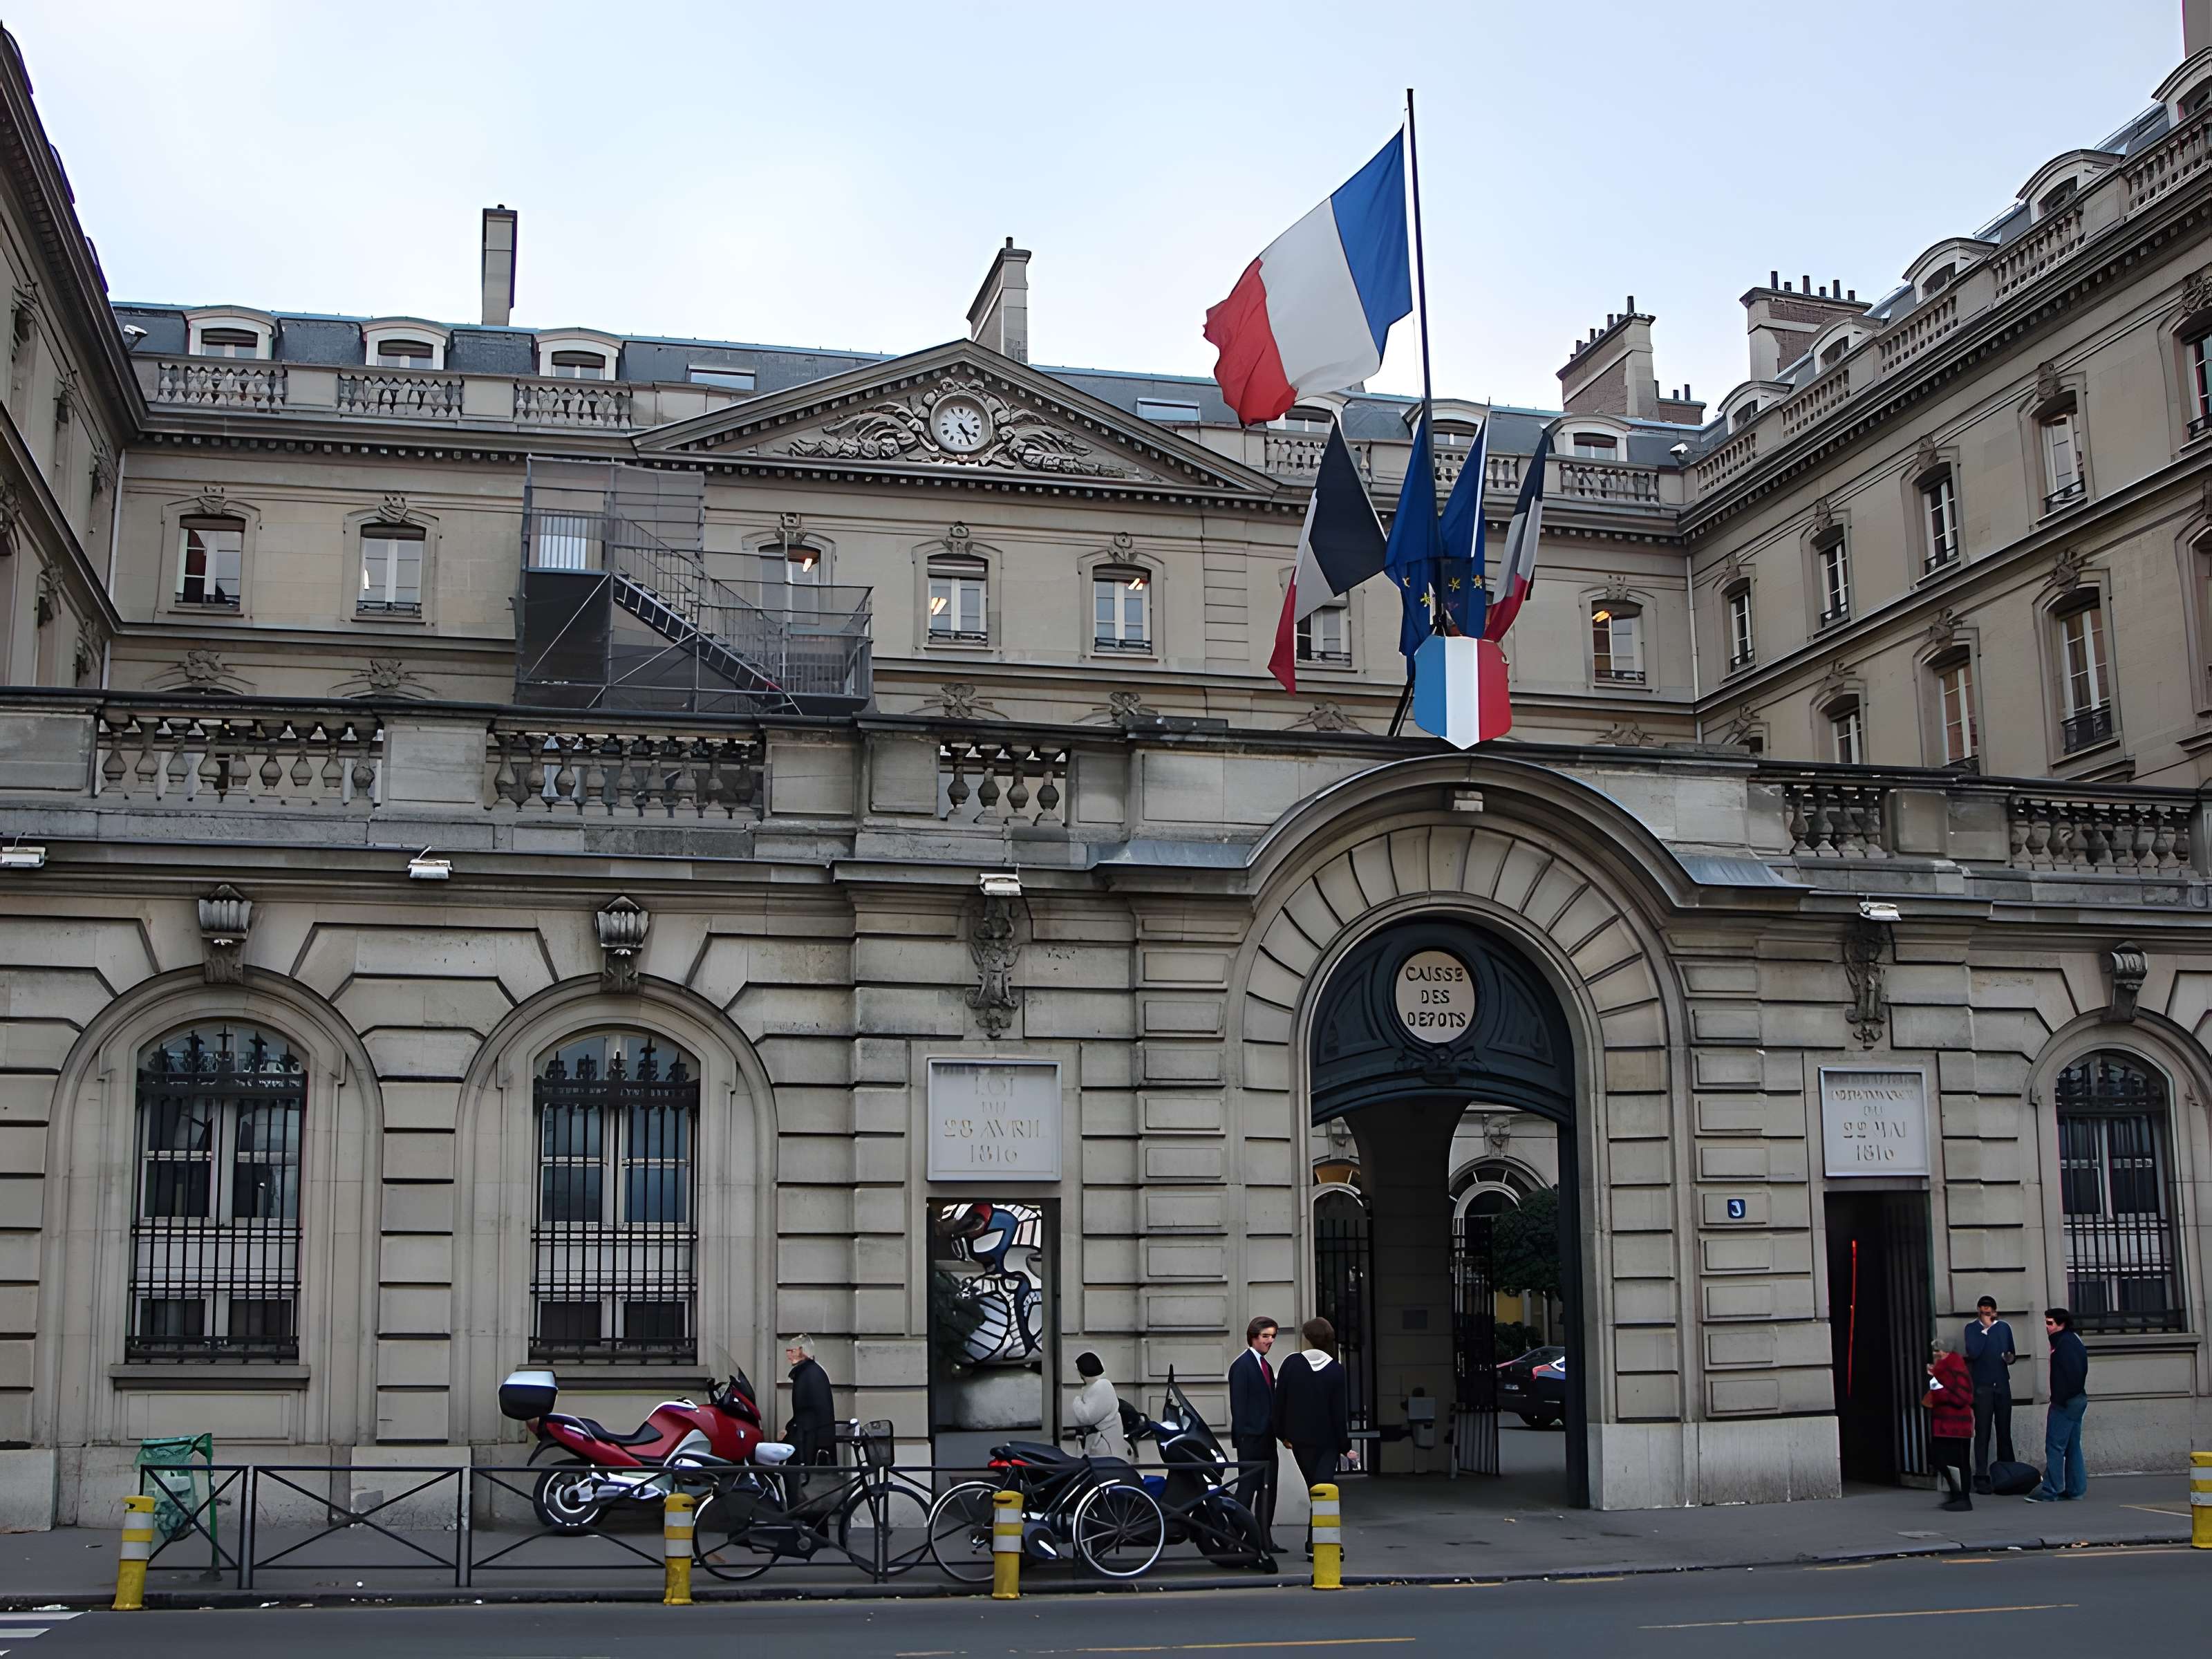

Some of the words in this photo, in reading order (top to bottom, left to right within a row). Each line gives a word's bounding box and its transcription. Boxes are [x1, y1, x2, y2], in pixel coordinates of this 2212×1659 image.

[1405, 966, 1463, 982] CAISSE
[1421, 989, 1450, 1004] DES
[944, 1119, 973, 1138] 28
[971, 1144, 1018, 1163] 1816
